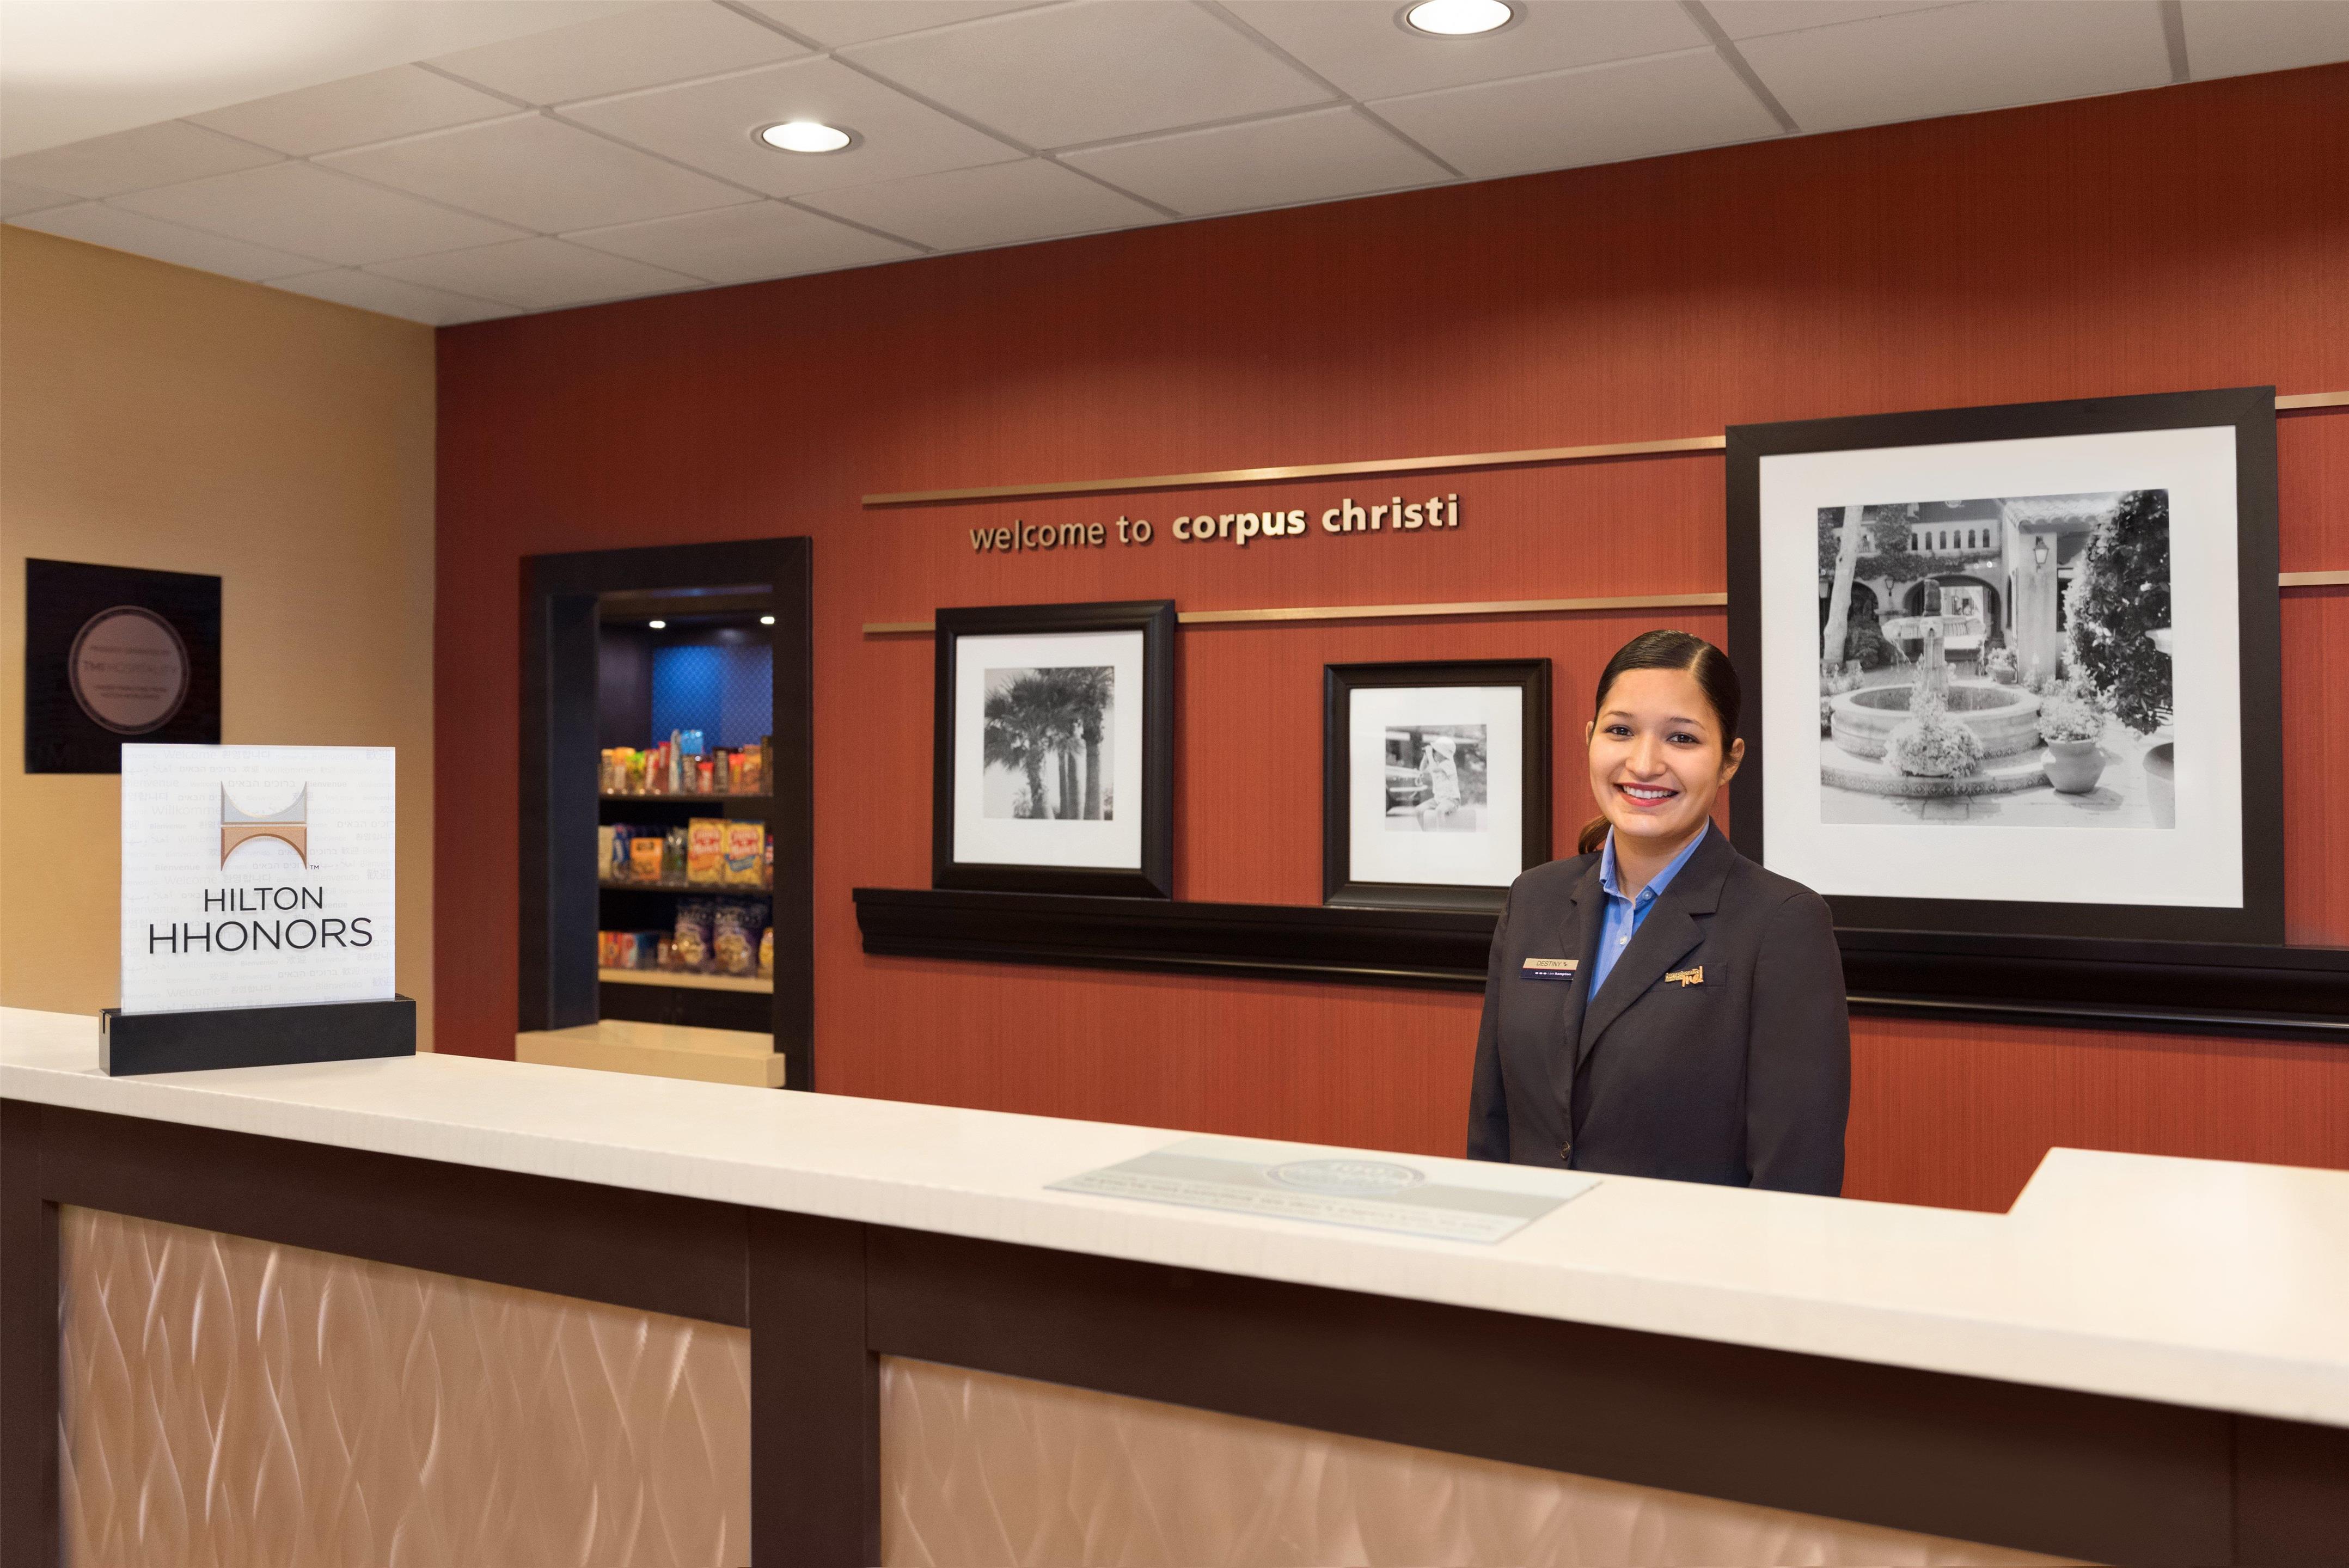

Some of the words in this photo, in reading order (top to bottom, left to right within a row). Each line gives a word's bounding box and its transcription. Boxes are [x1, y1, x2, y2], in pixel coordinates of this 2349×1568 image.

[969, 519, 1106, 550] welcome
[1116, 515, 1151, 543] to
[1172, 509, 1306, 545] corpus
[1322, 494, 1459, 532] christi
[163, 750, 216, 759] Welcome
[151, 804, 222, 815] Willkomme
[164, 875, 217, 885] Welcome
[205, 886, 323, 912] HILTON
[150, 917, 372, 954] HHONORS
[167, 987, 221, 997] Welcome
